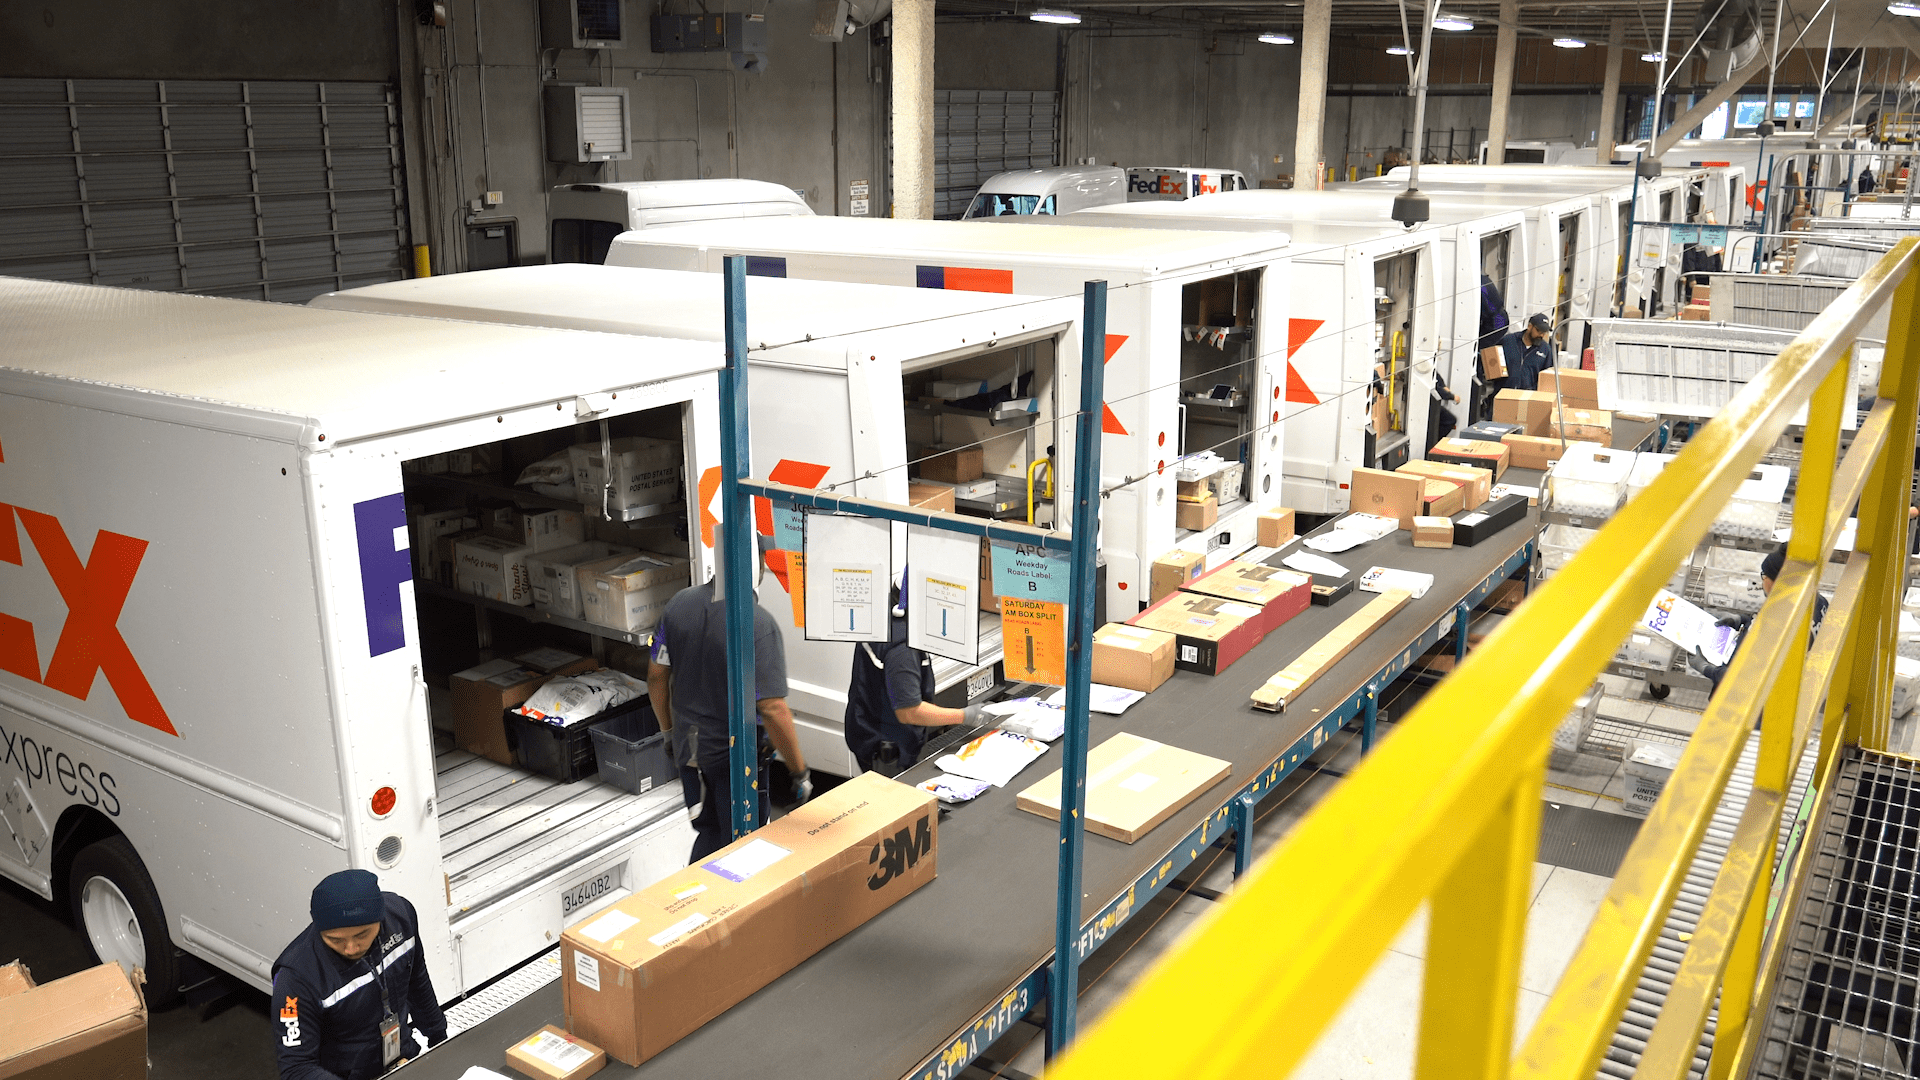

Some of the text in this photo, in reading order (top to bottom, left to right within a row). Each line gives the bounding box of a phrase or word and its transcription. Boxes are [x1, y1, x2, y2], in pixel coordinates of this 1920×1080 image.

[1128, 174, 1183, 194] FedEx
[631, 467, 674, 482] UNITED STATES
[629, 482, 651, 493] POSTAL
[652, 477, 676, 488] SERVICE
[1015, 543, 1047, 558] APC
[1015, 560, 1048, 571] Weekday
[1007, 567, 1053, 580] Roads Label:
[510, 562, 522, 601] Thank
[1028, 581, 1037, 592] B
[1361, 580, 1375, 588] FedEx
[1004, 599, 1046, 610] SATURDAY
[1004, 609, 1057, 621] AM BOX SPLIT
[1648, 595, 1676, 632] FedEx
[0, 725, 121, 818] xpress
[1632, 793, 1657, 803] POSTA
[1636, 787, 1659, 797] UNITE
[819, 822, 831, 830] not
[830, 813, 848, 825] stand
[856, 800, 870, 811] end
[867, 814, 932, 891] 3M
[564, 875, 611, 912] 34640B2
[280, 996, 302, 1047] FedEx
